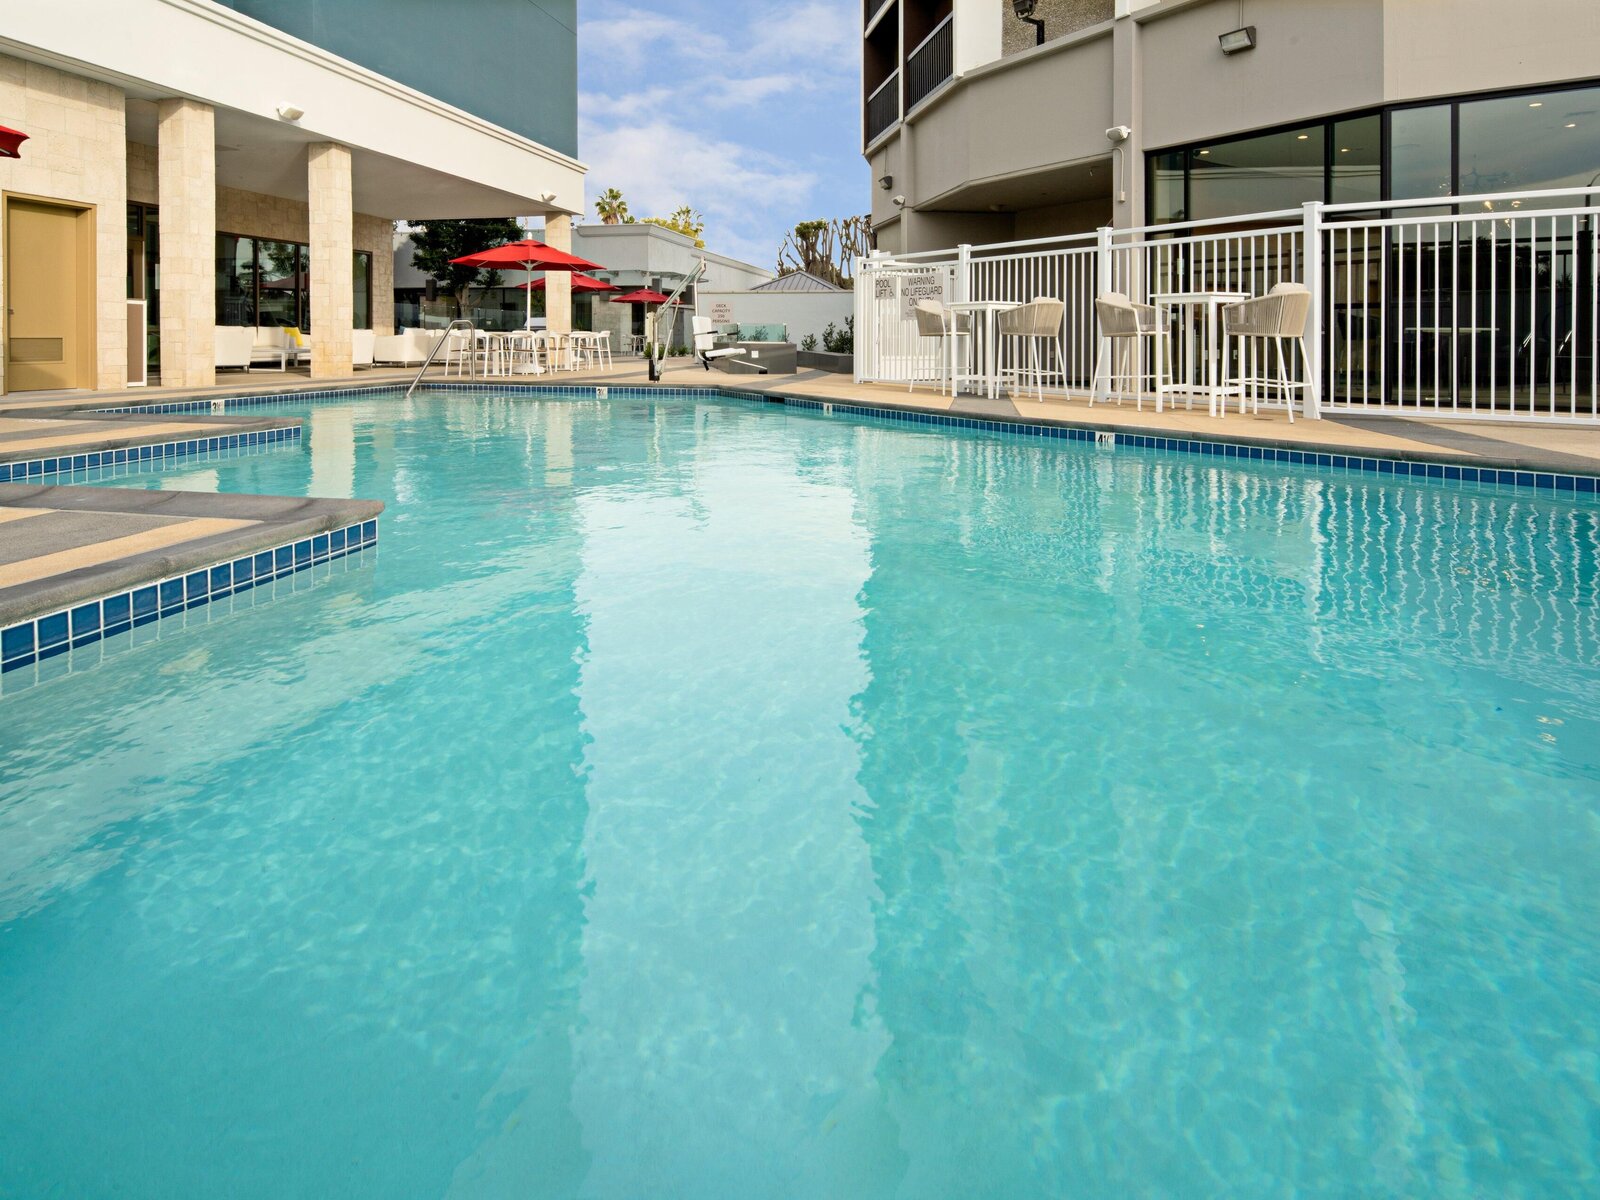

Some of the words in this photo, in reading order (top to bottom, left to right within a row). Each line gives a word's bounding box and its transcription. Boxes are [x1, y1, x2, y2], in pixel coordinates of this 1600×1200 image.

[875, 280, 891, 288] POOL
[907, 276, 935, 286] WARNING
[875, 289, 887, 298] LIFT
[901, 288, 909, 297] NO
[911, 286, 943, 297] LIFEGUARD
[908, 297, 918, 306] ON
